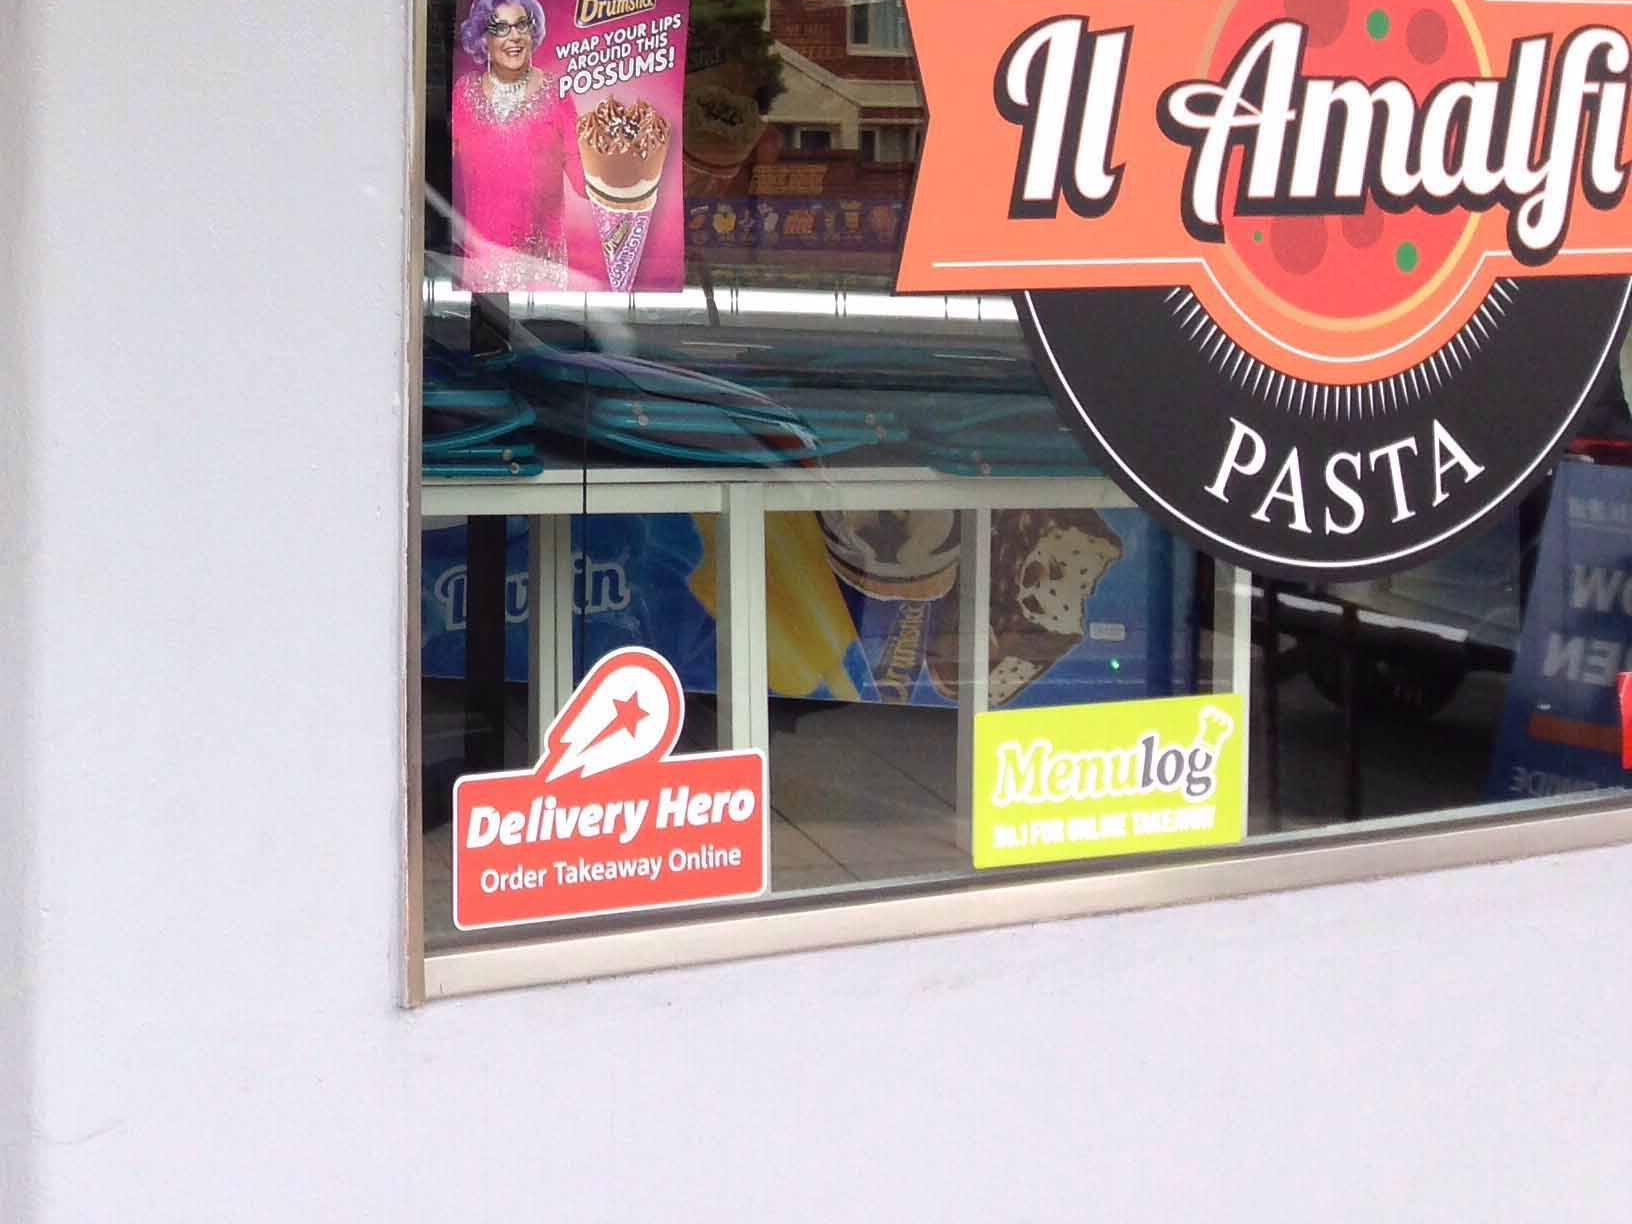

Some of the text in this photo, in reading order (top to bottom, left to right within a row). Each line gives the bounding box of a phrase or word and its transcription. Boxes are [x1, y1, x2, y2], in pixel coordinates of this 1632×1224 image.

[556, 14, 681, 59] WRAP YOUR LIPS
[636, 33, 668, 53] THIS
[559, 46, 675, 99] POSSUMS!
[1157, 18, 1632, 266] Amalfi
[1205, 418, 1485, 534] PASTA
[993, 733, 1215, 806] Menulog
[466, 786, 755, 849] Delivery Hero
[480, 844, 742, 894] Order Takeaway Online
